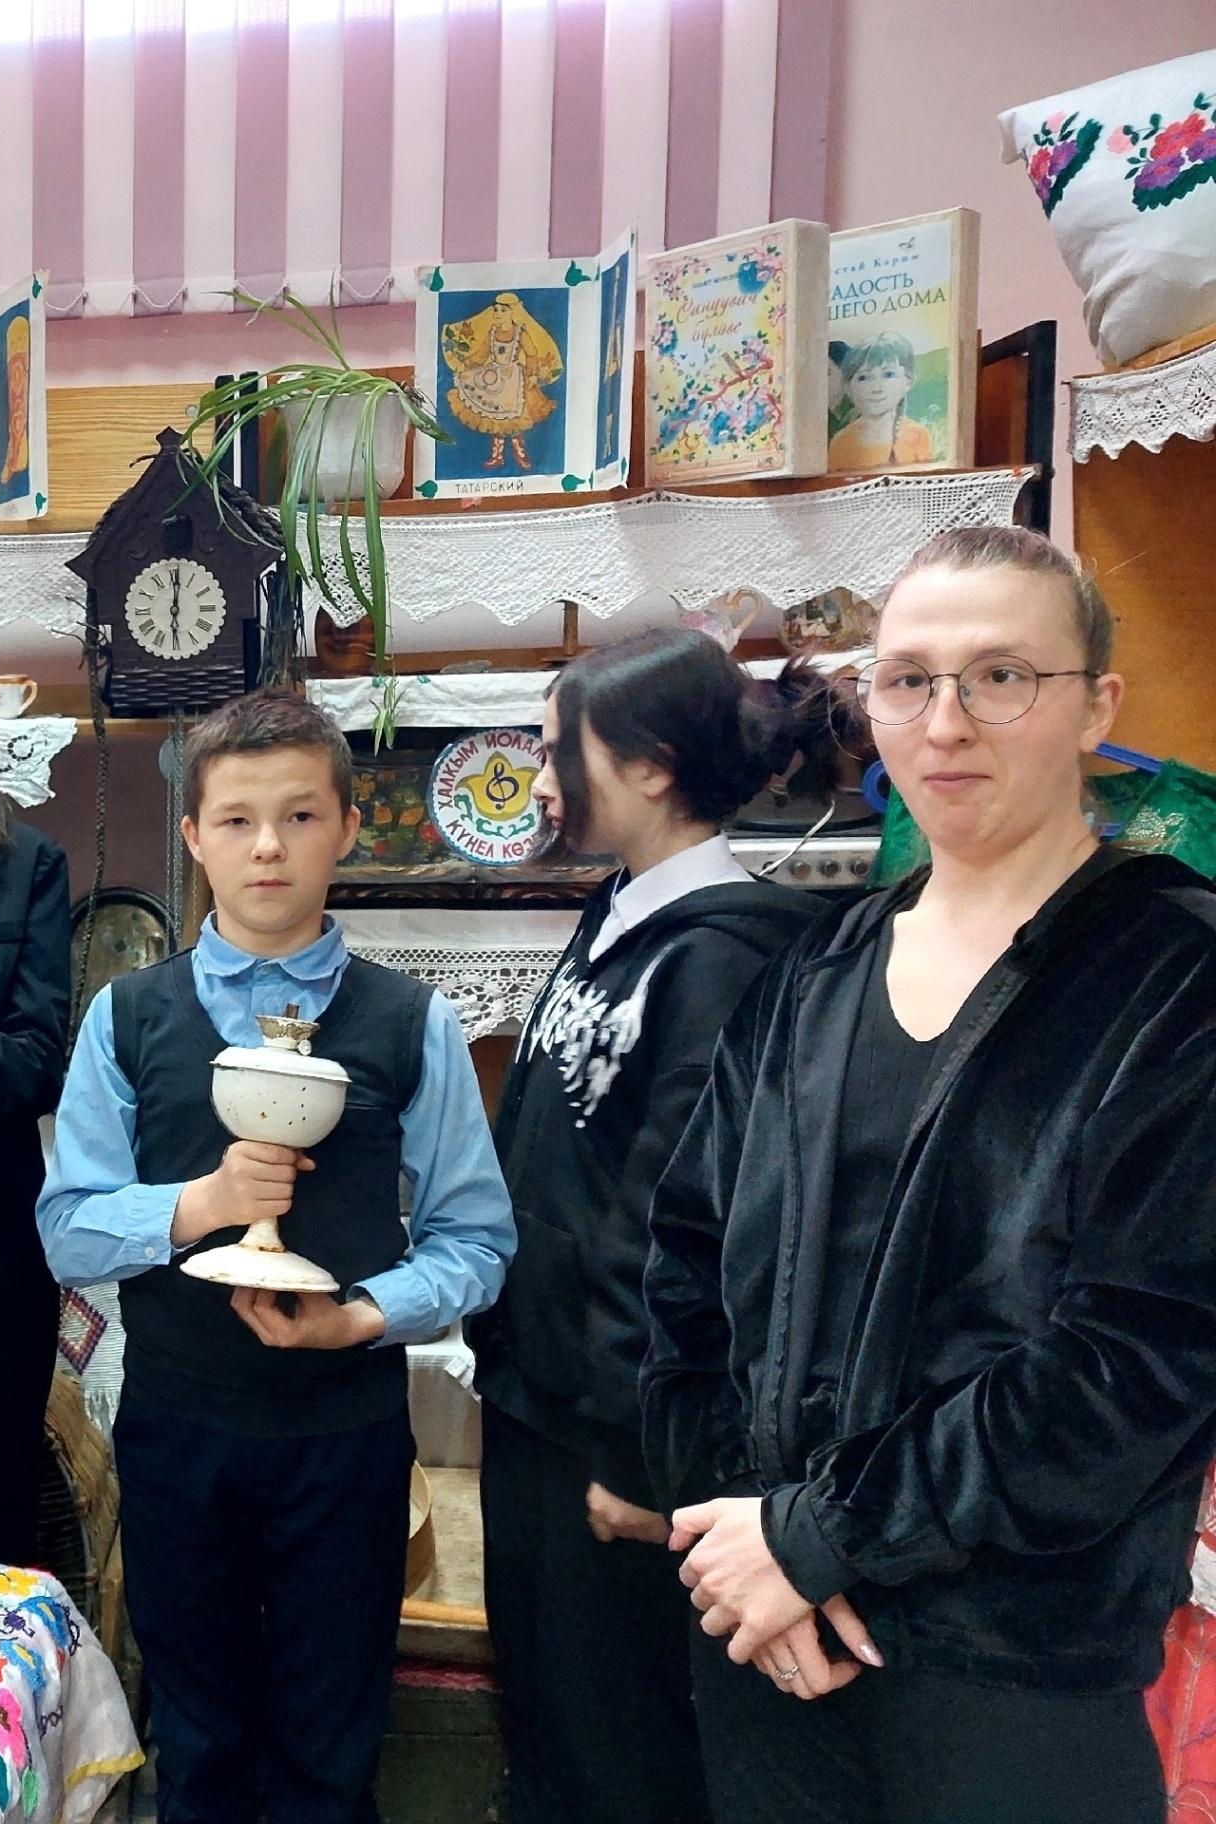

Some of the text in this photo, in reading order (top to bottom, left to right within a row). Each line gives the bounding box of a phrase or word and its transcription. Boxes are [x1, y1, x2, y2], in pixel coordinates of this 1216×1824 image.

[834, 261, 865, 275] стай
[831, 273, 914, 301] АДОСТЬ
[828, 287, 946, 321] ШЕГО ДОМА
[455, 479, 524, 495] ТАТАРСКИЙ
[437, 740, 479, 811] ХАЛКЫМ
